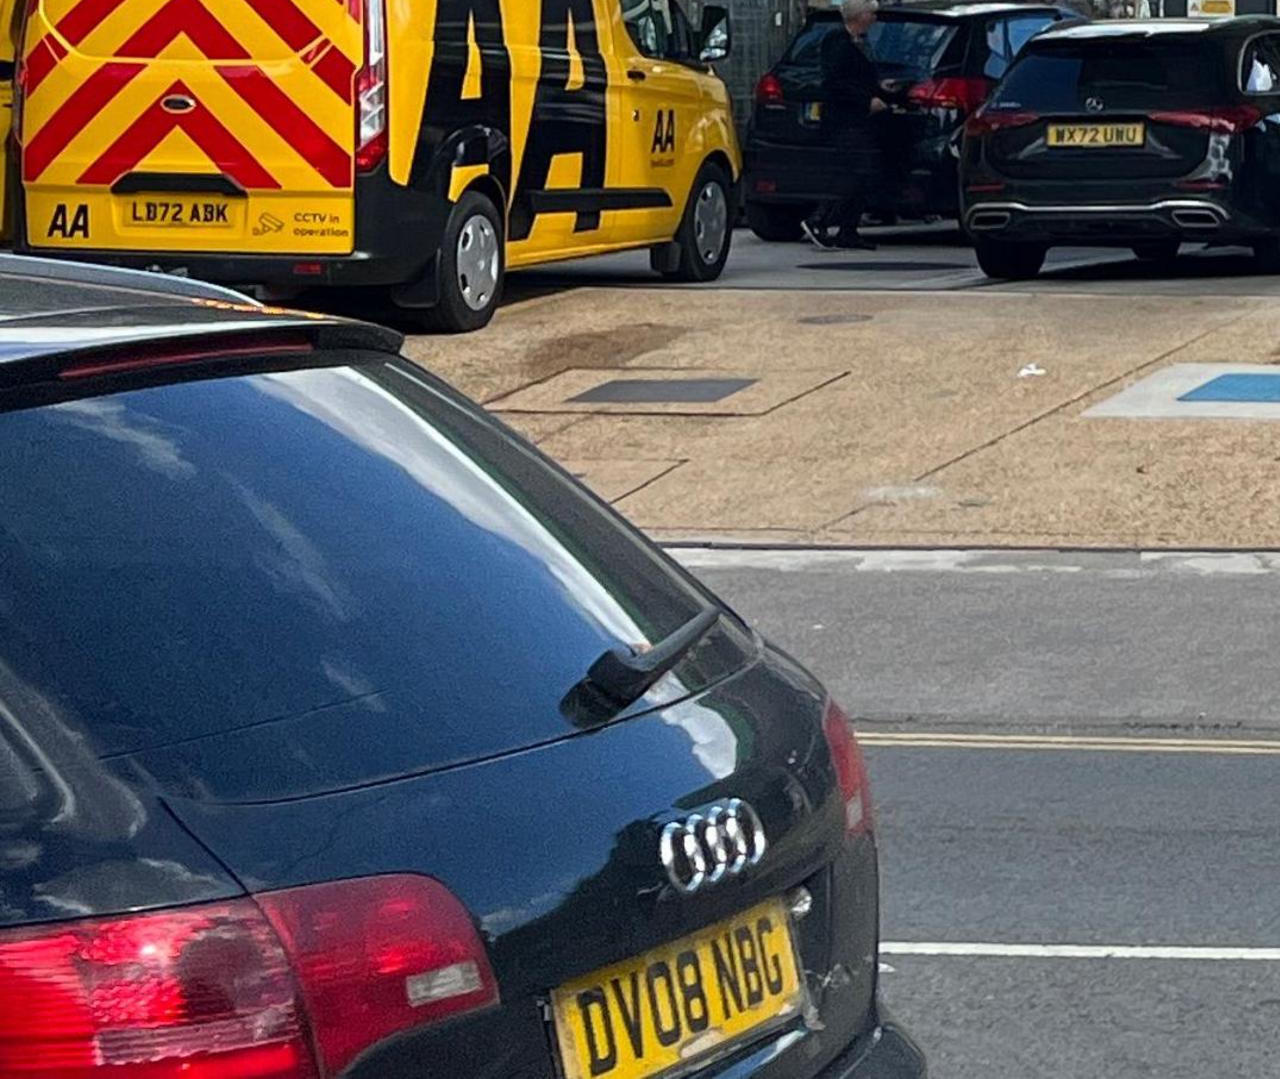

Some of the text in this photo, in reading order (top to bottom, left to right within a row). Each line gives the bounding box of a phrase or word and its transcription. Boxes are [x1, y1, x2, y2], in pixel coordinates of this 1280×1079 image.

[651, 109, 675, 154] AA
[47, 204, 90, 239] AA
[132, 202, 228, 223] LD72 ABK
[293, 212, 340, 224] CCTV in
[293, 227, 349, 239] operation
[577, 915, 783, 1077] DV08 NBG
